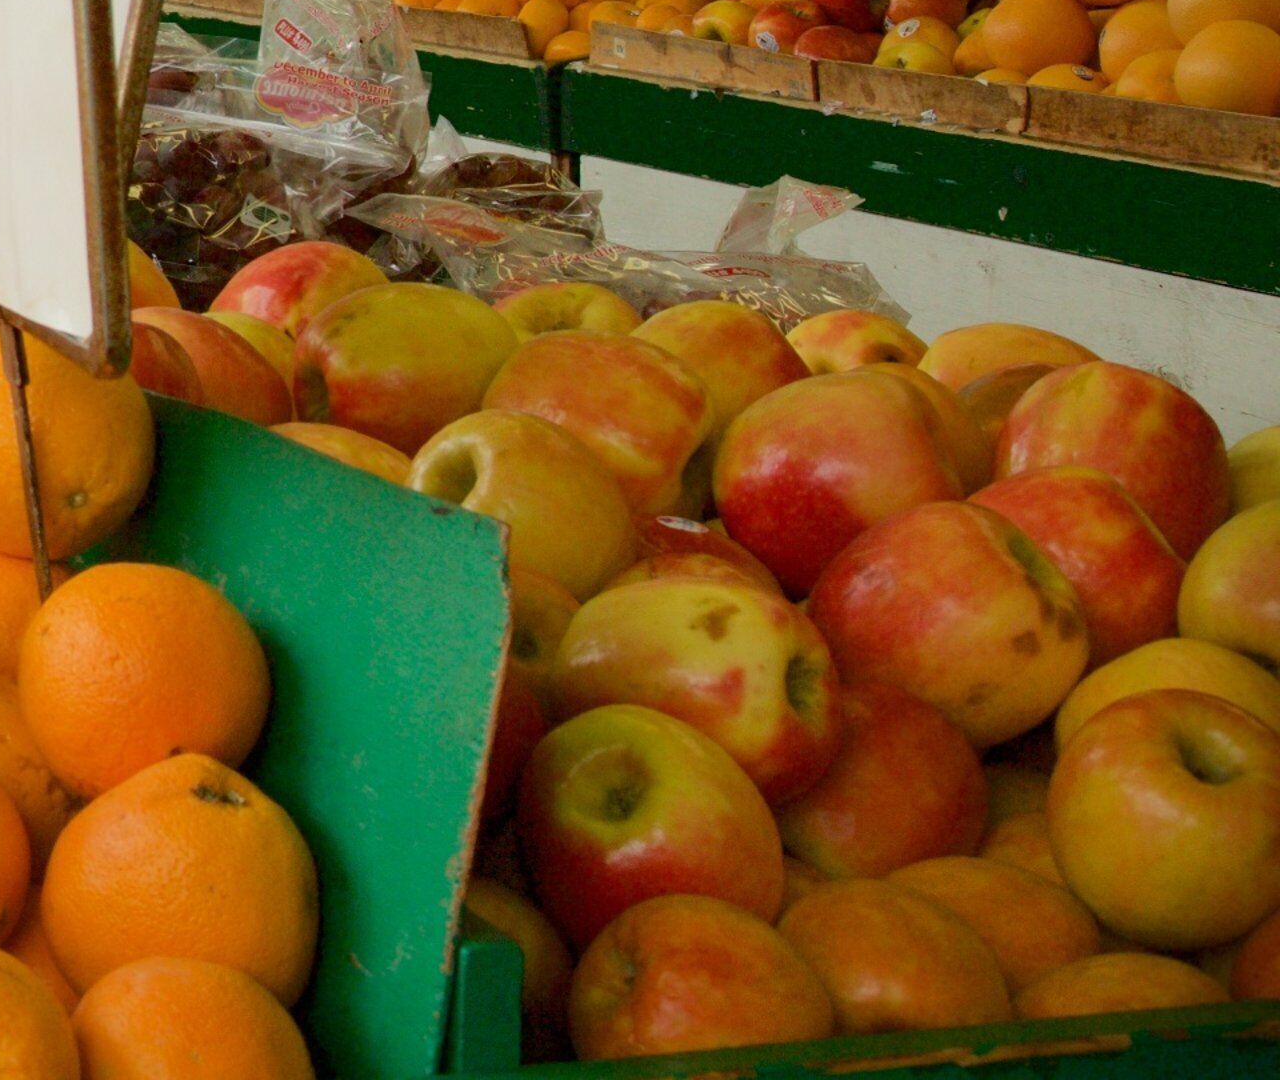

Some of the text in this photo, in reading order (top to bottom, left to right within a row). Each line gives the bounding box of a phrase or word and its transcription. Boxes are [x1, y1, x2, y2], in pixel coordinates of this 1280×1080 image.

[274, 61, 340, 86] December
[360, 79, 393, 97] April
[341, 86, 391, 107] Season
